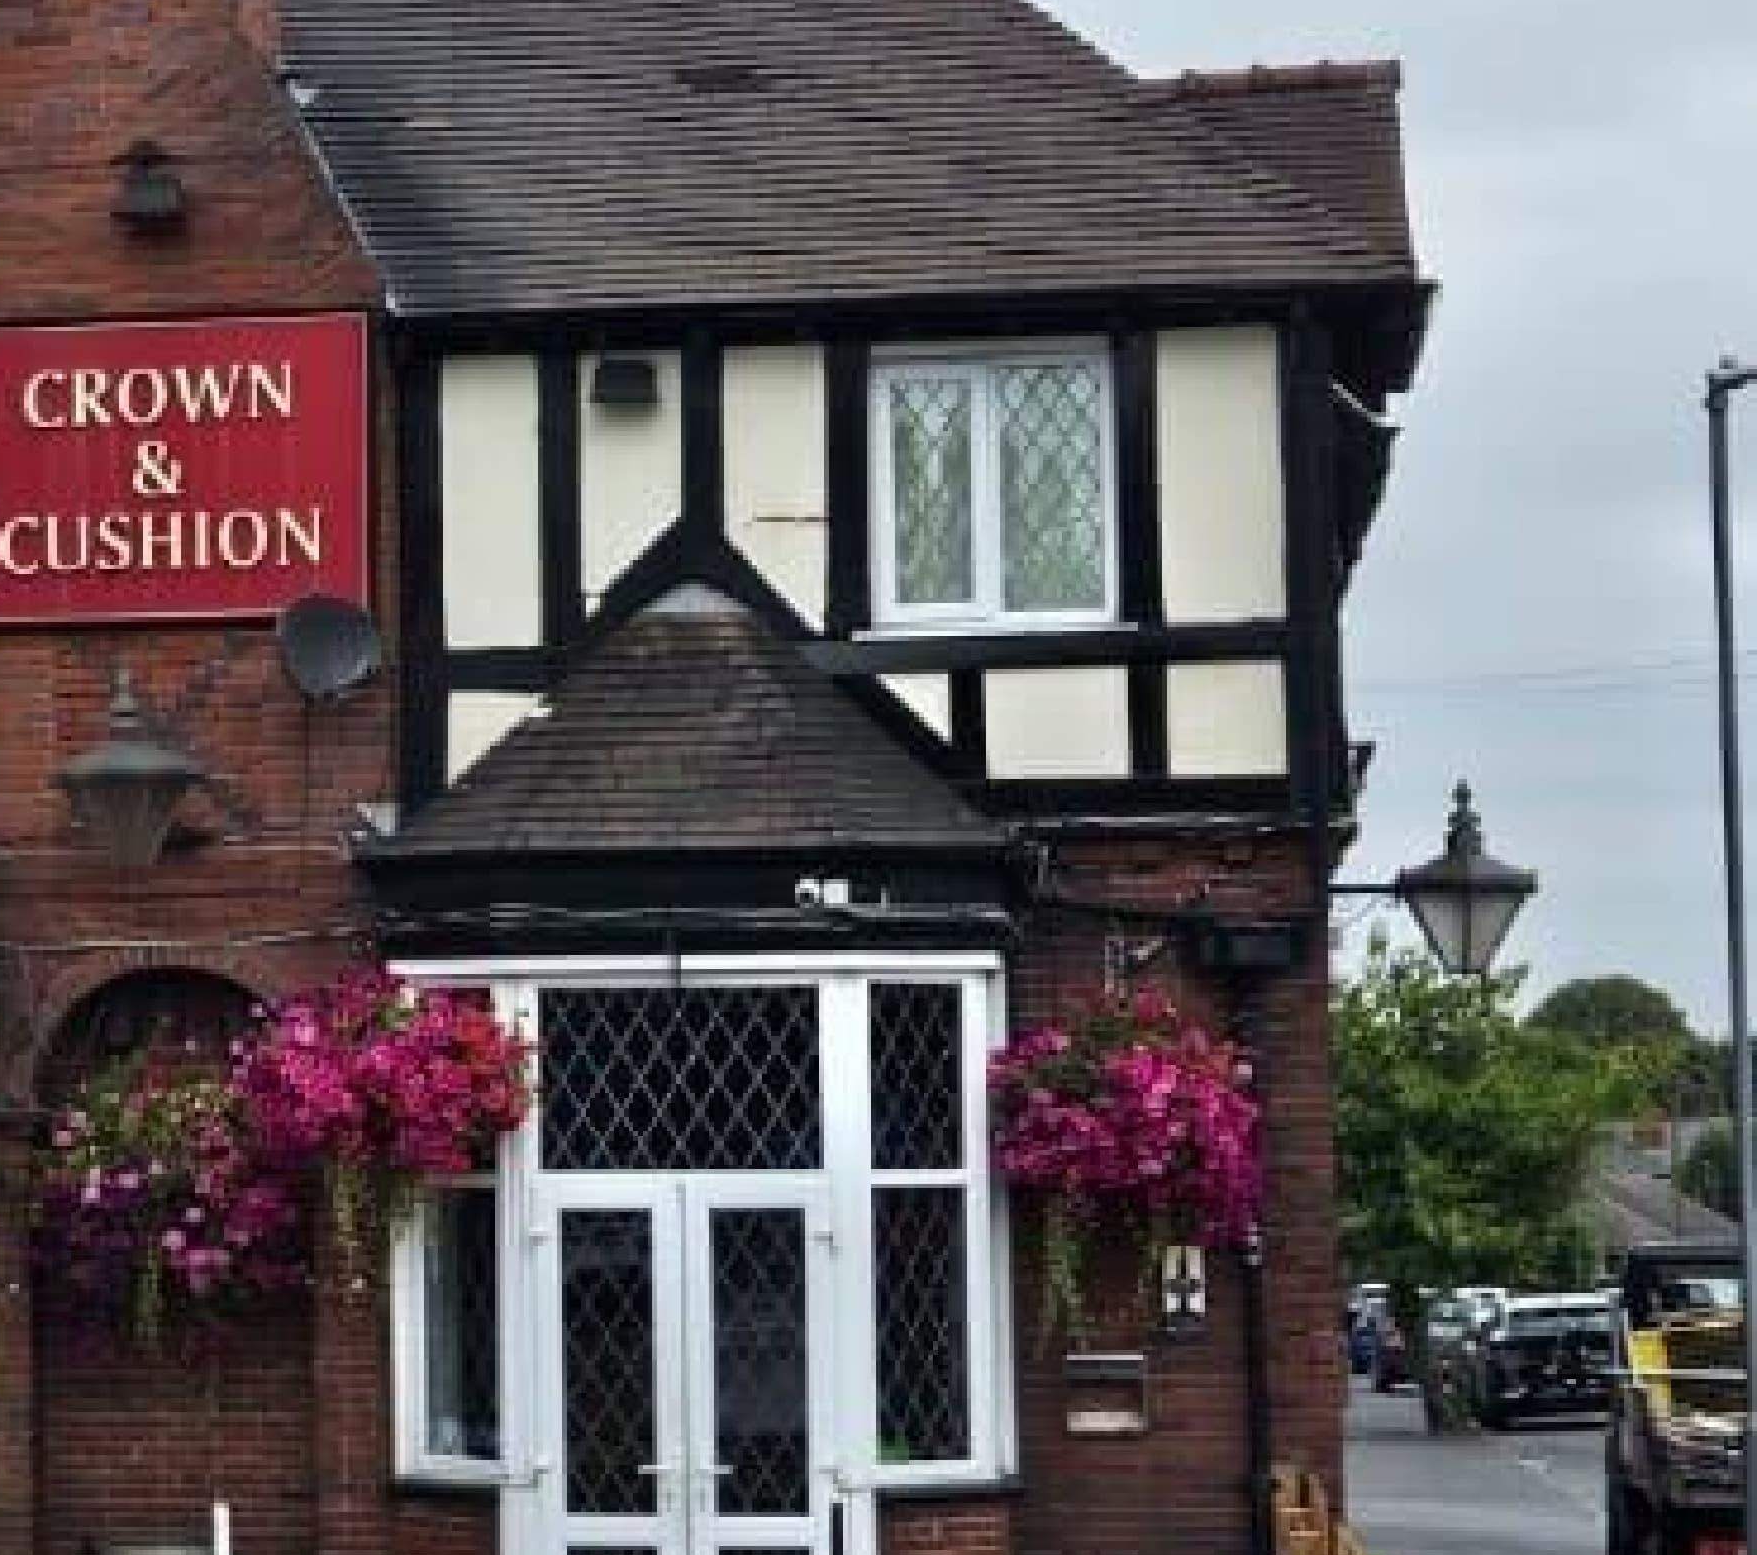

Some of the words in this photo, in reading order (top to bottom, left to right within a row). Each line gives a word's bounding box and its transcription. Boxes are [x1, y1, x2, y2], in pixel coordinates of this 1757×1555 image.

[22, 360, 292, 428] CROWN
[133, 441, 185, 495] &
[0, 508, 321, 575] CUSHION
